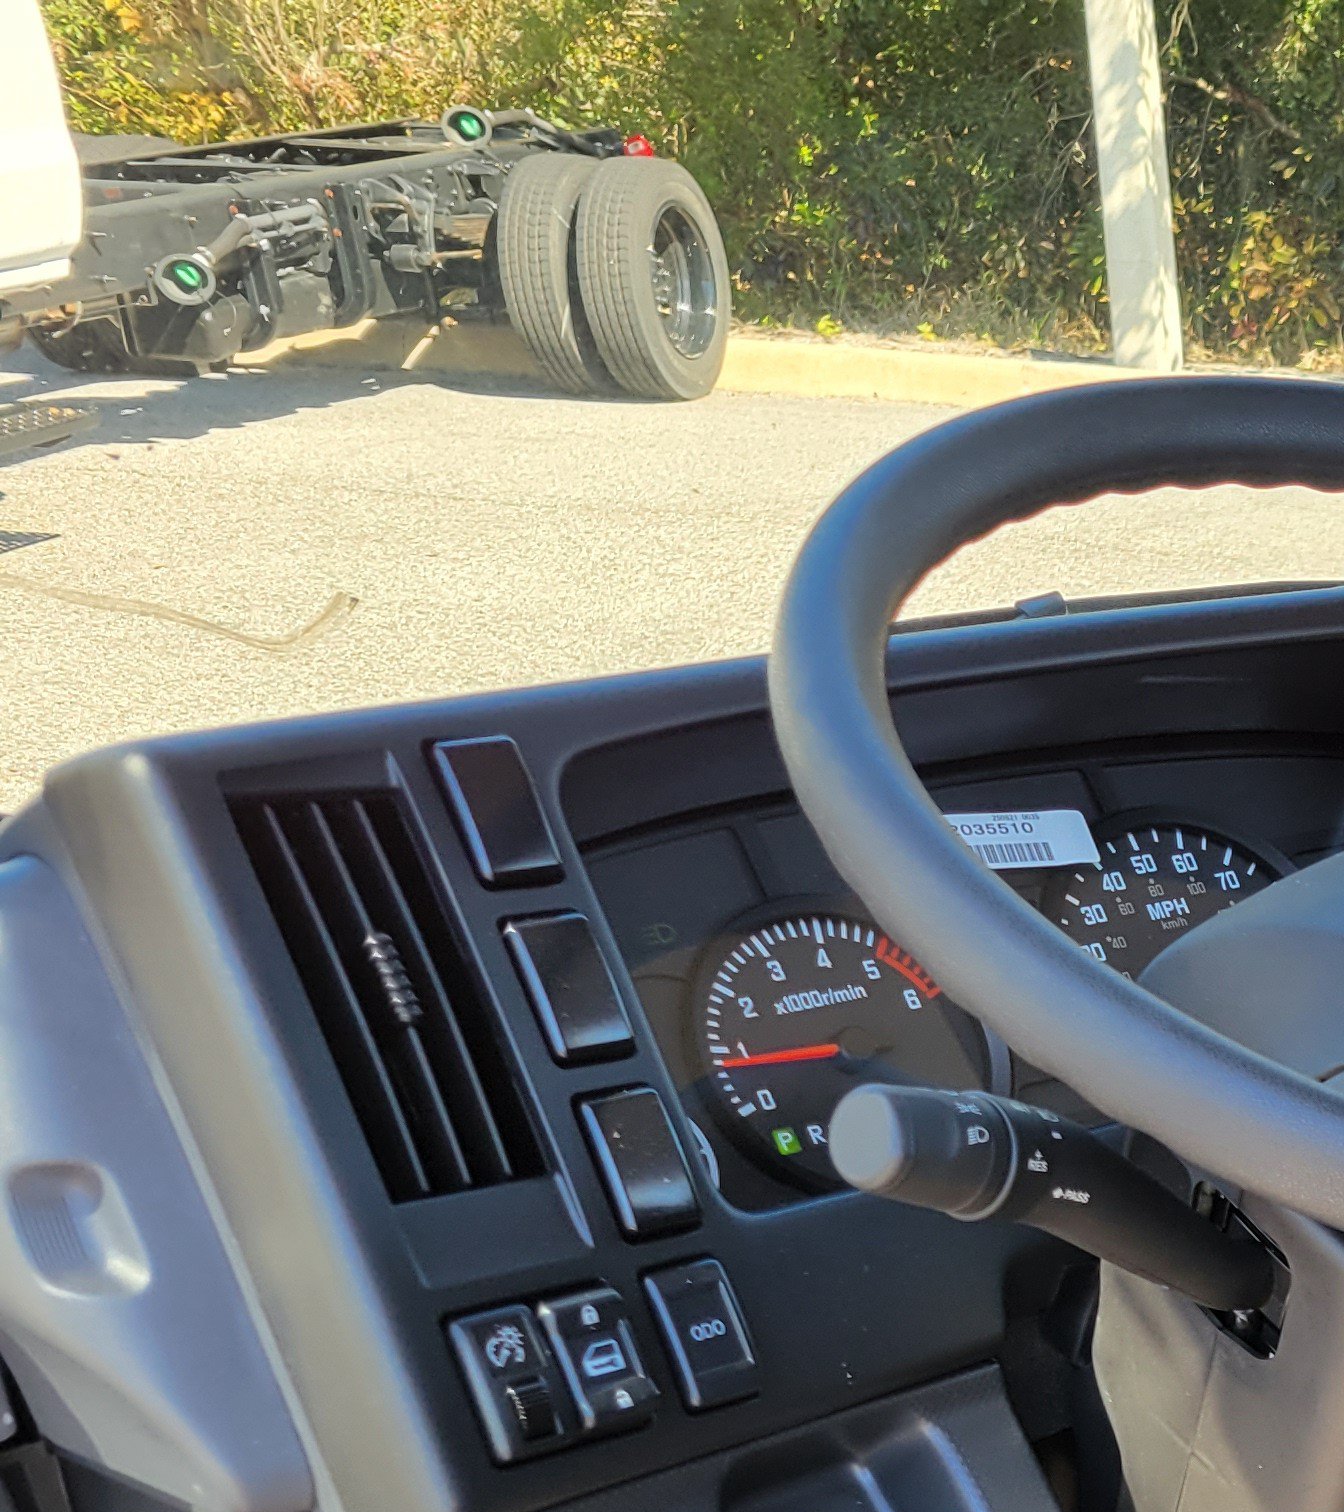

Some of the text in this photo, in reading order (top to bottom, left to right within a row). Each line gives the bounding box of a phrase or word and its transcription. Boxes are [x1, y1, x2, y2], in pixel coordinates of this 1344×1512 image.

[1129, 853, 1158, 875] 50
[1171, 852, 1199, 874] 60
[1102, 871, 1127, 893] 40
[1148, 884, 1165, 898] 80
[1186, 881, 1207, 896] 100
[1213, 870, 1241, 891] 70
[1080, 904, 1109, 926] 30
[1118, 902, 1136, 916] 60
[1146, 897, 1191, 921] MPH
[1161, 917, 1189, 931] km/h
[1111, 936, 1128, 950] 40
[816, 948, 833, 969] 4
[766, 960, 787, 982] 3
[862, 959, 882, 981] 5
[738, 996, 760, 1019] 2
[903, 988, 923, 1011] 6
[736, 1041, 751, 1059] 1
[756, 1088, 778, 1111] 0
[776, 1124, 828, 1149] P R
[690, 1318, 727, 1342] ODO
